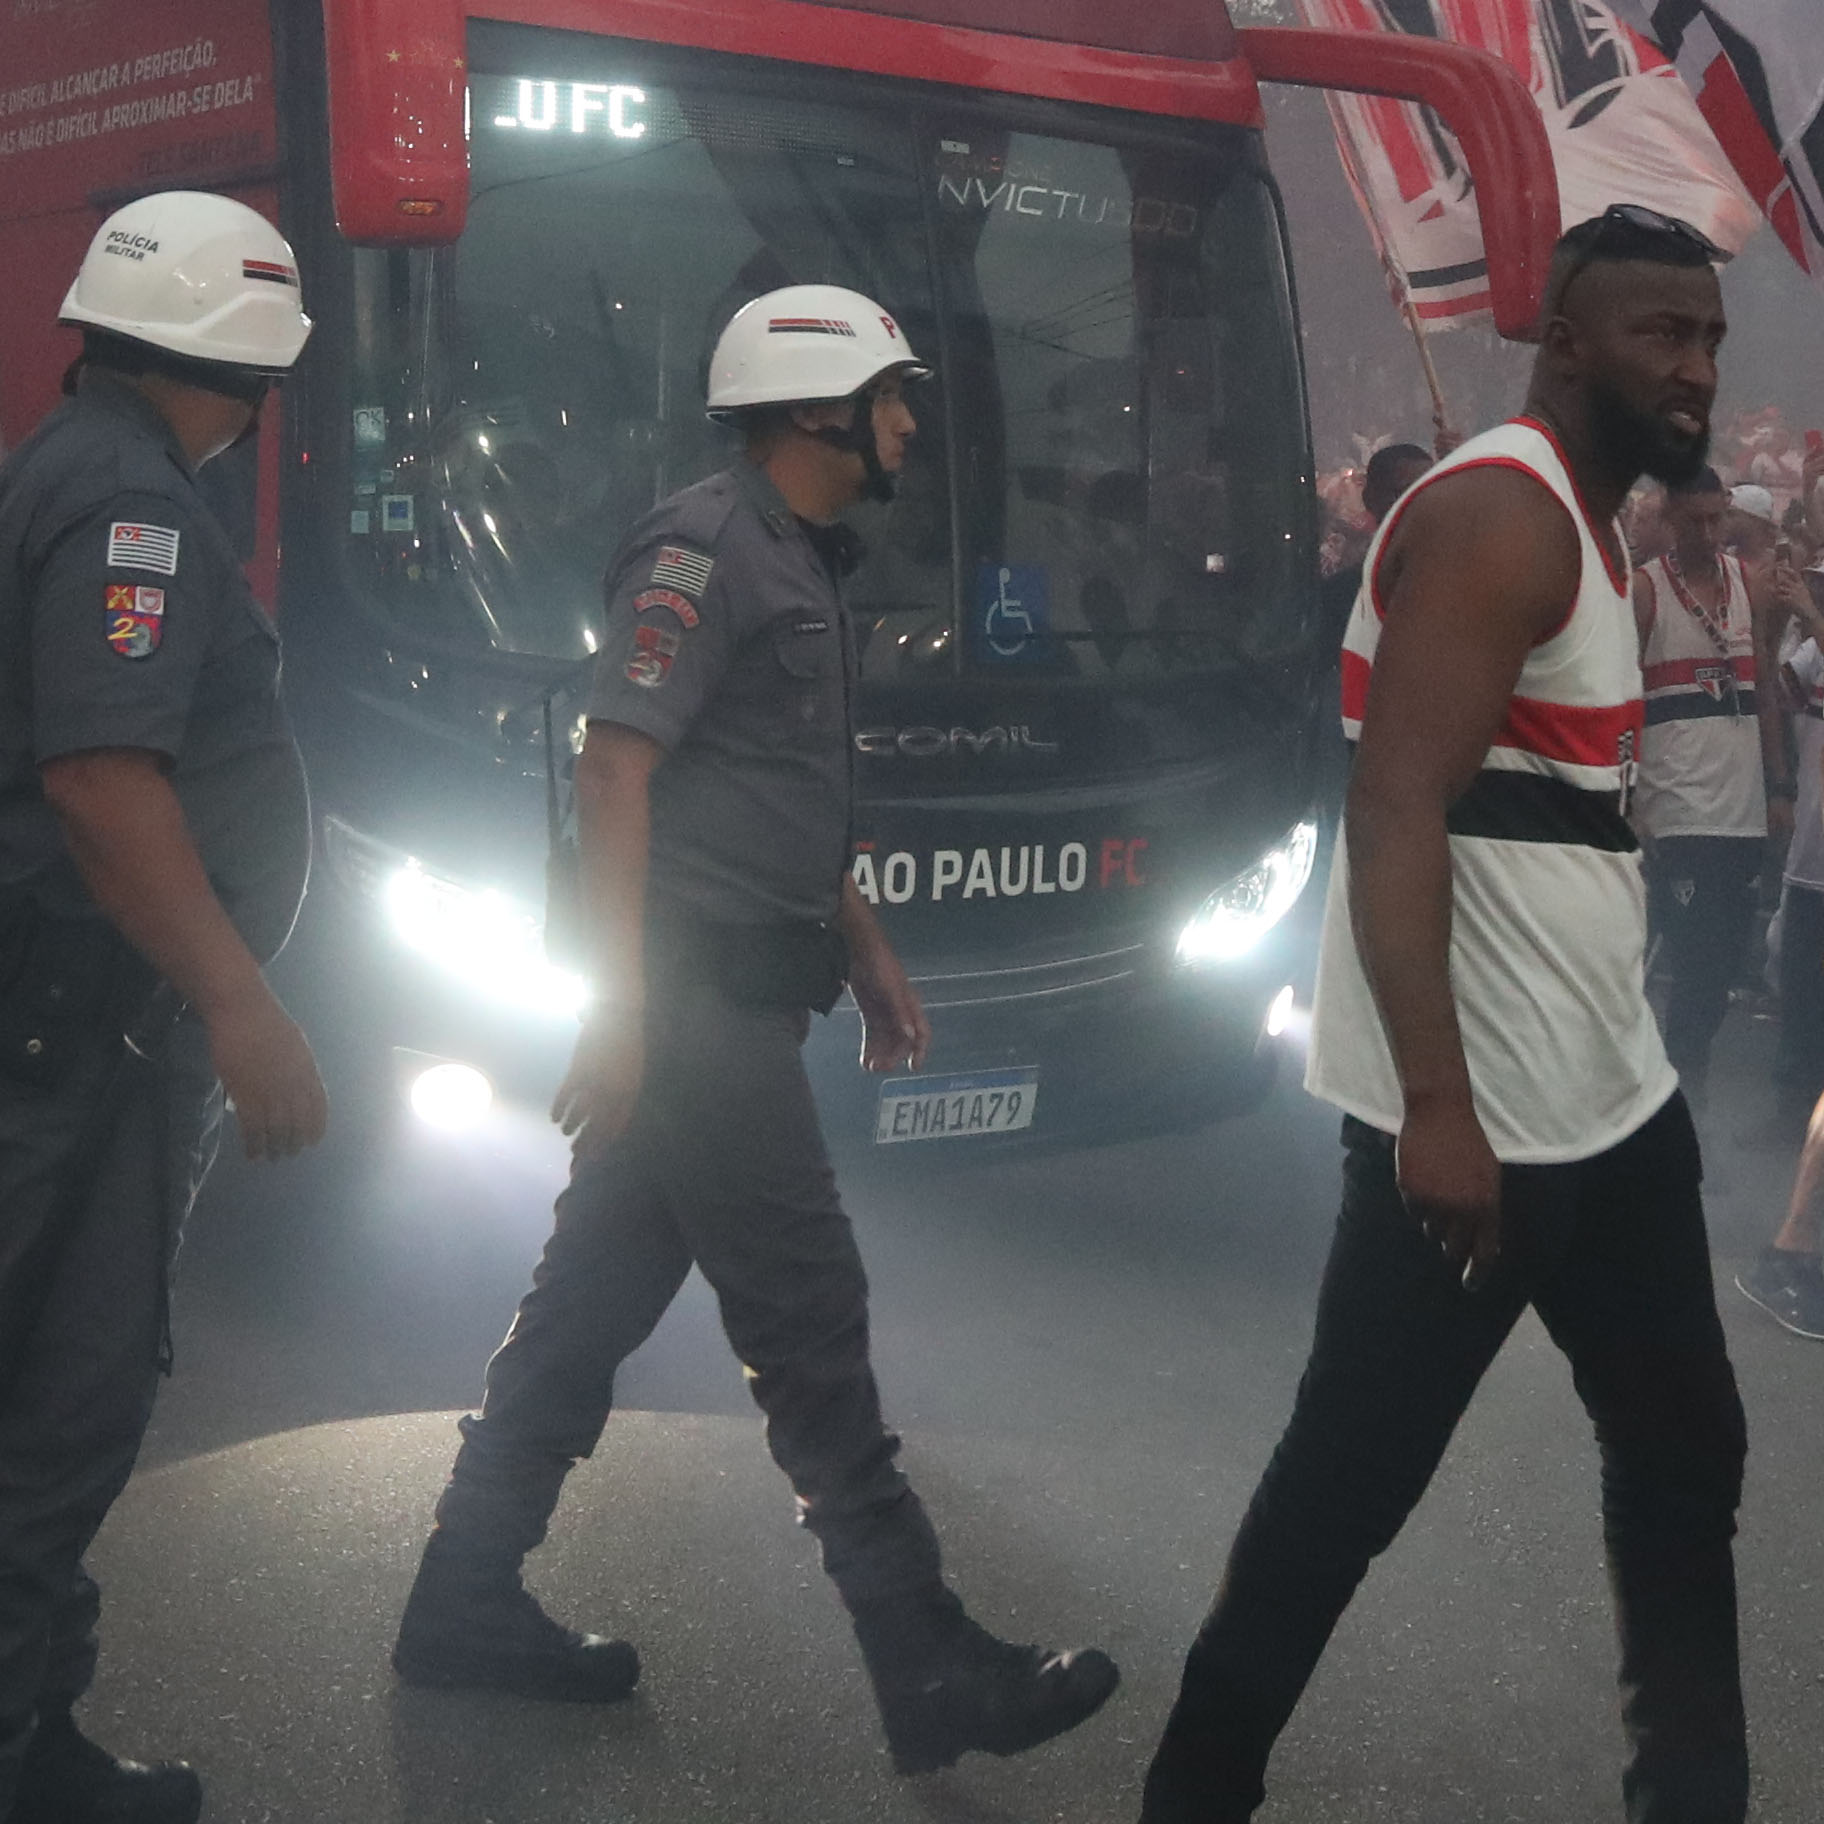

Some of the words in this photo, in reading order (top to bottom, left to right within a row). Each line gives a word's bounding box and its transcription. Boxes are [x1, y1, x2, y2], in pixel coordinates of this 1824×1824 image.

[19, 118, 44, 153] NÃO
[56, 104, 99, 141] DIFÍCIL
[100, 83, 211, 134] APROXIMAR-SE
[571, 82, 647, 139] FC
[104, 243, 146, 263] MILITAR
[106, 229, 160, 255] POLÍCIA
[107, 616, 139, 642] 2
[851, 840, 917, 905] ÃO
[931, 841, 1088, 902] PAULO
[1097, 837, 1149, 890] FC
[891, 1090, 1023, 1136] EMA1A79
